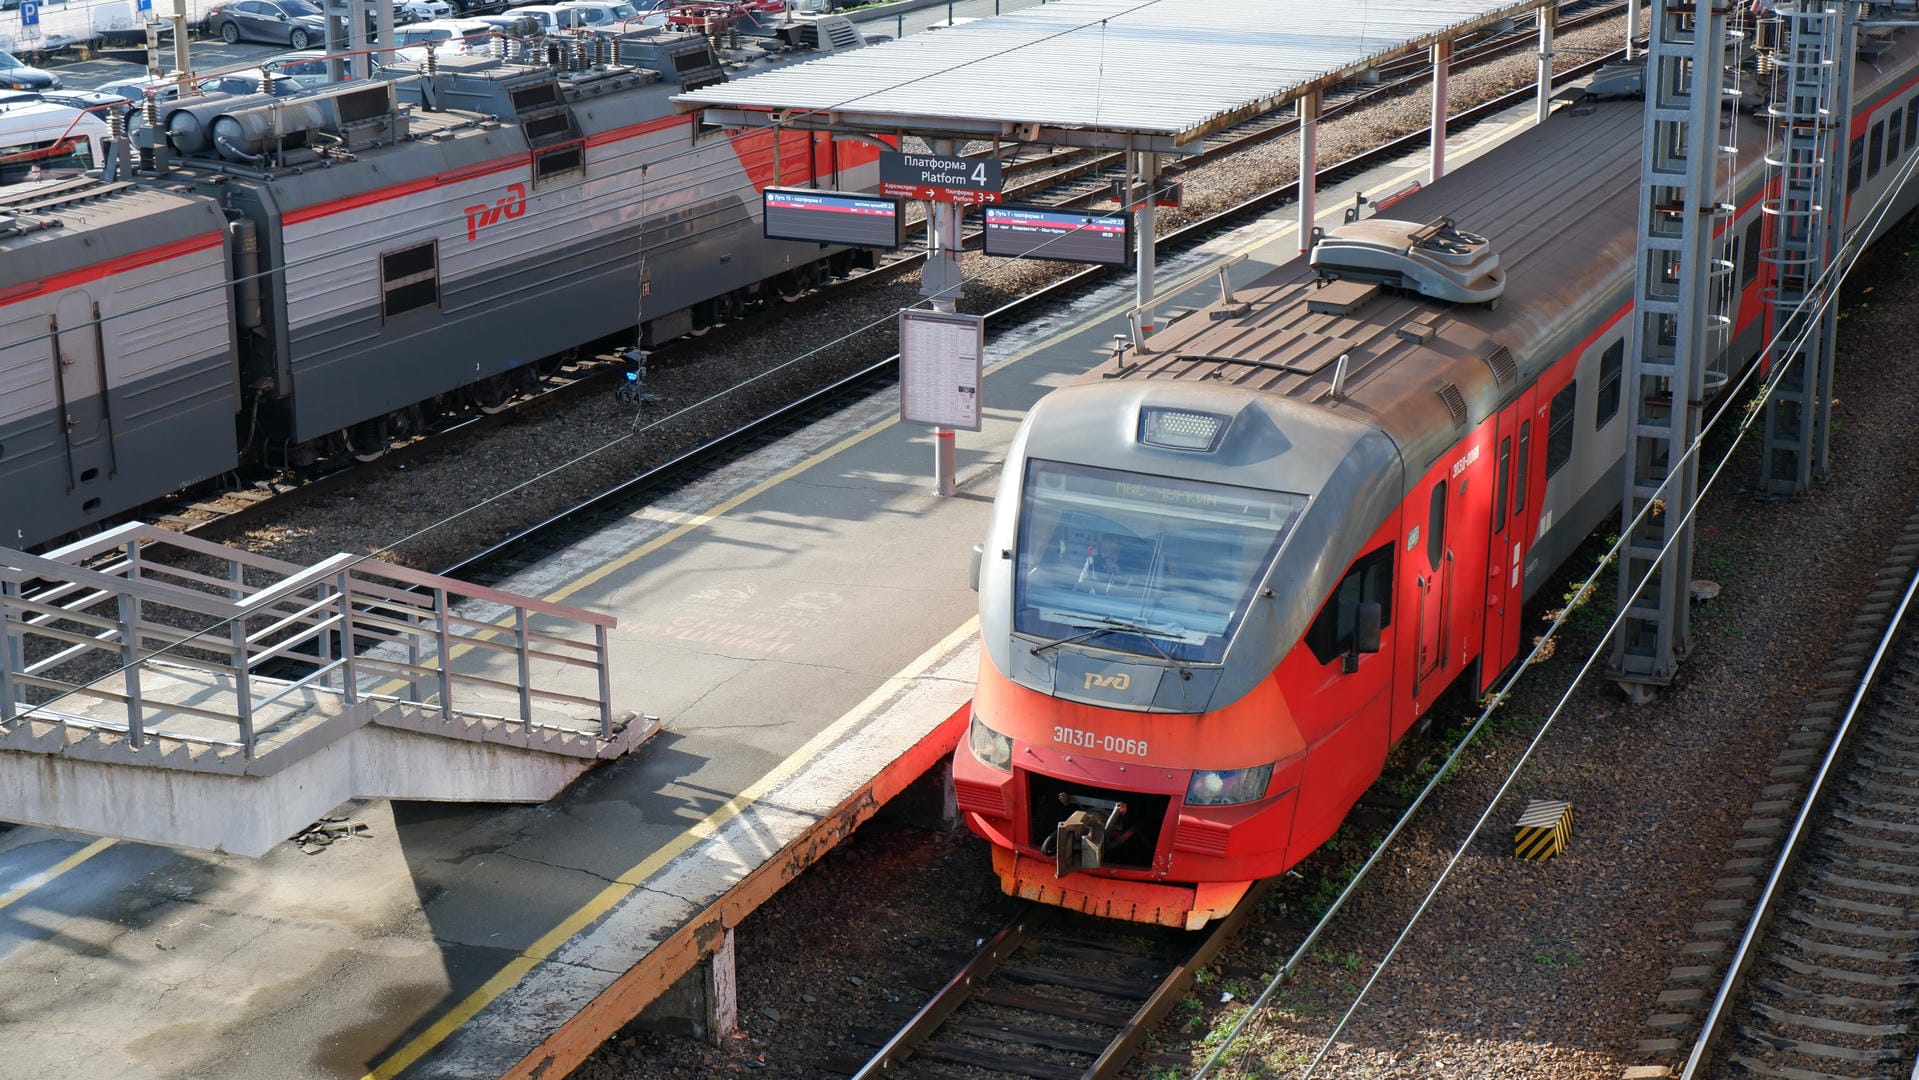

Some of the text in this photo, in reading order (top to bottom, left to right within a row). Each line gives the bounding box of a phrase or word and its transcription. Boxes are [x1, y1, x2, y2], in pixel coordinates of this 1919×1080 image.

[904, 156, 967, 170] Платформа
[921, 171, 966, 185] Platform
[971, 162, 987, 187] 4
[945, 188, 974, 197] Платформа
[978, 193, 984, 202] 3
